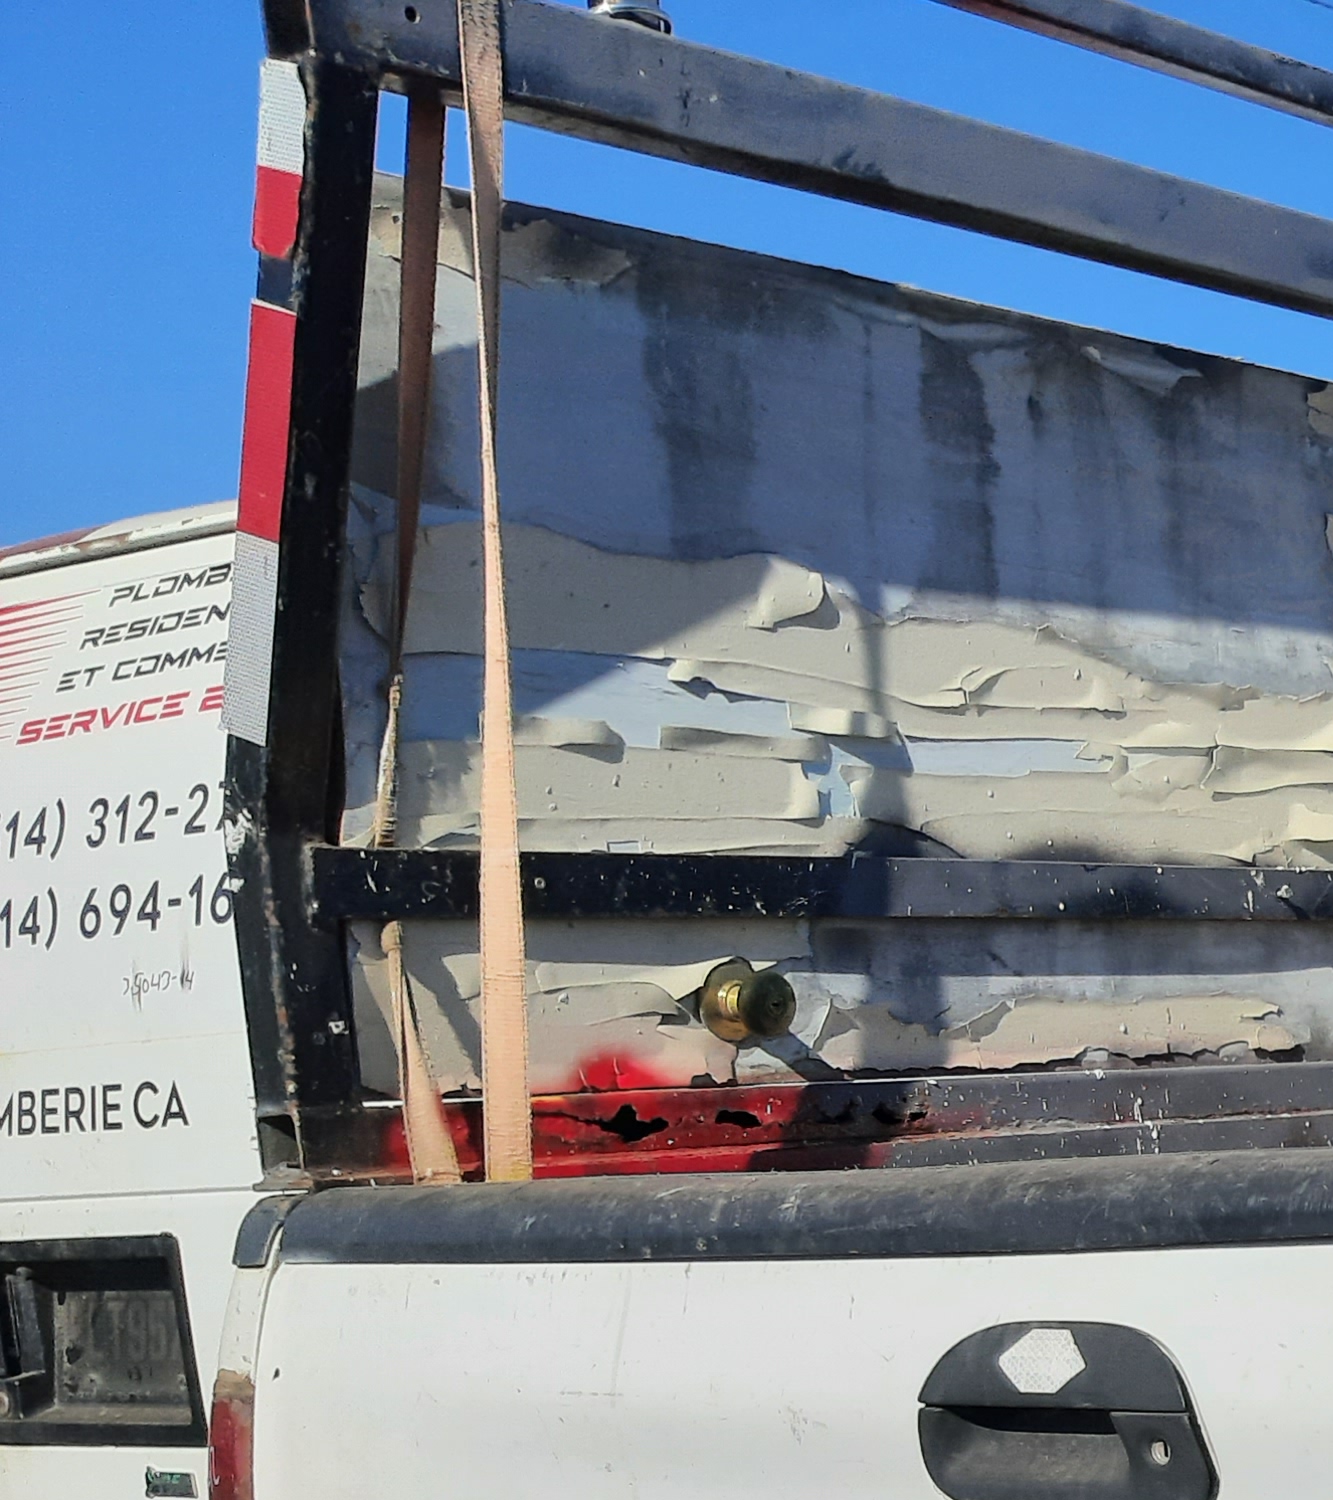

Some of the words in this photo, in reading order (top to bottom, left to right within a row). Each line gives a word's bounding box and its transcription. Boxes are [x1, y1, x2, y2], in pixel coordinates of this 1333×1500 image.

[55, 664, 106, 694] ET
[15, 690, 192, 747] SERVICE
[78, 871, 234, 940] 694-16
